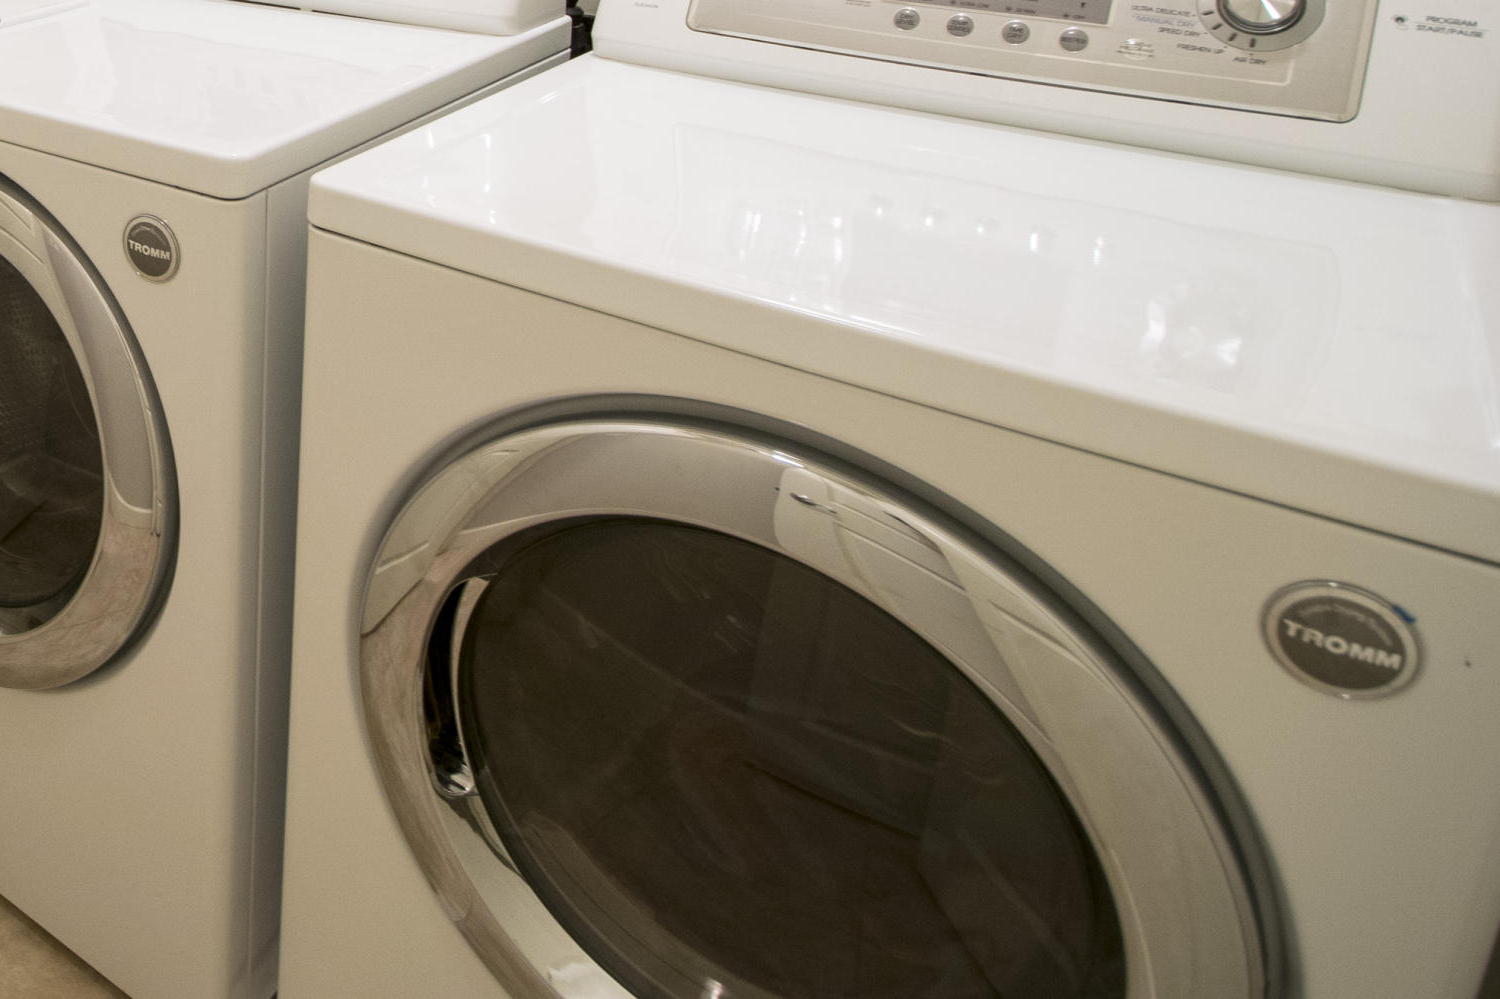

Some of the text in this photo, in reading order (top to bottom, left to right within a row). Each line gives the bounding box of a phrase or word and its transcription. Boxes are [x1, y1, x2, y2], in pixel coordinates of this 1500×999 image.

[1131, 4, 1192, 18] ULTRA DELICATE
[1158, 26, 1201, 37] SPEED DRY
[1176, 43, 1211, 53] FRESHEN
[1249, 57, 1268, 66] DRY
[128, 239, 171, 261] TROMM
[1282, 617, 1402, 671] TROMM
